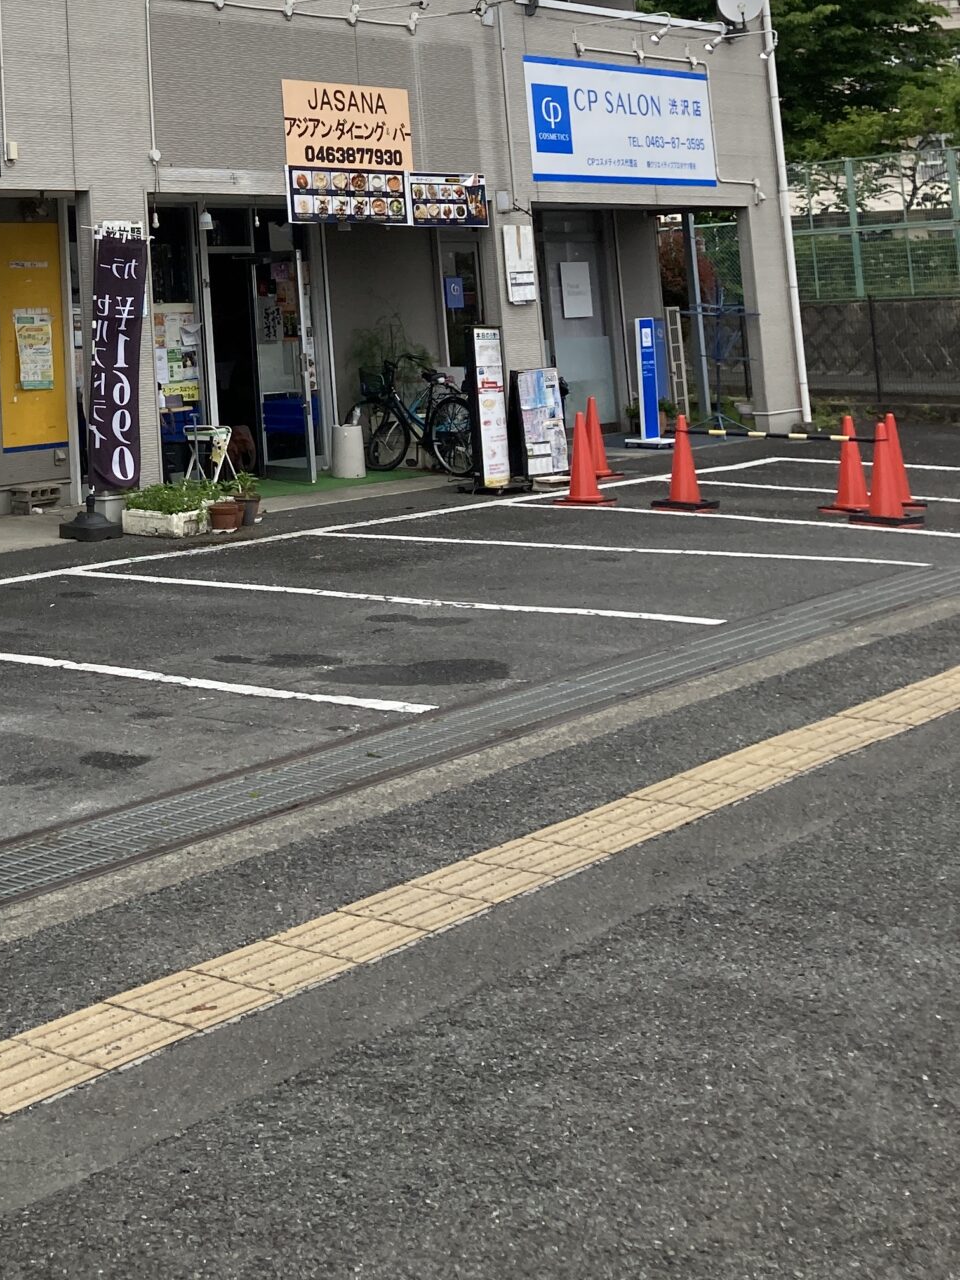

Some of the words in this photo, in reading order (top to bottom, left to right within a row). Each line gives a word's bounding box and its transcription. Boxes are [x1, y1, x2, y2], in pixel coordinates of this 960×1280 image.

[307, 87, 387, 114] JASANA
[573, 88, 598, 112] CP
[604, 91, 662, 117] SALON
[668, 98, 702, 117] 渋沢店
[538, 131, 570, 142] COSMETICS
[627, 135, 644, 148] TEL.
[304, 144, 403, 166] 0463877930
